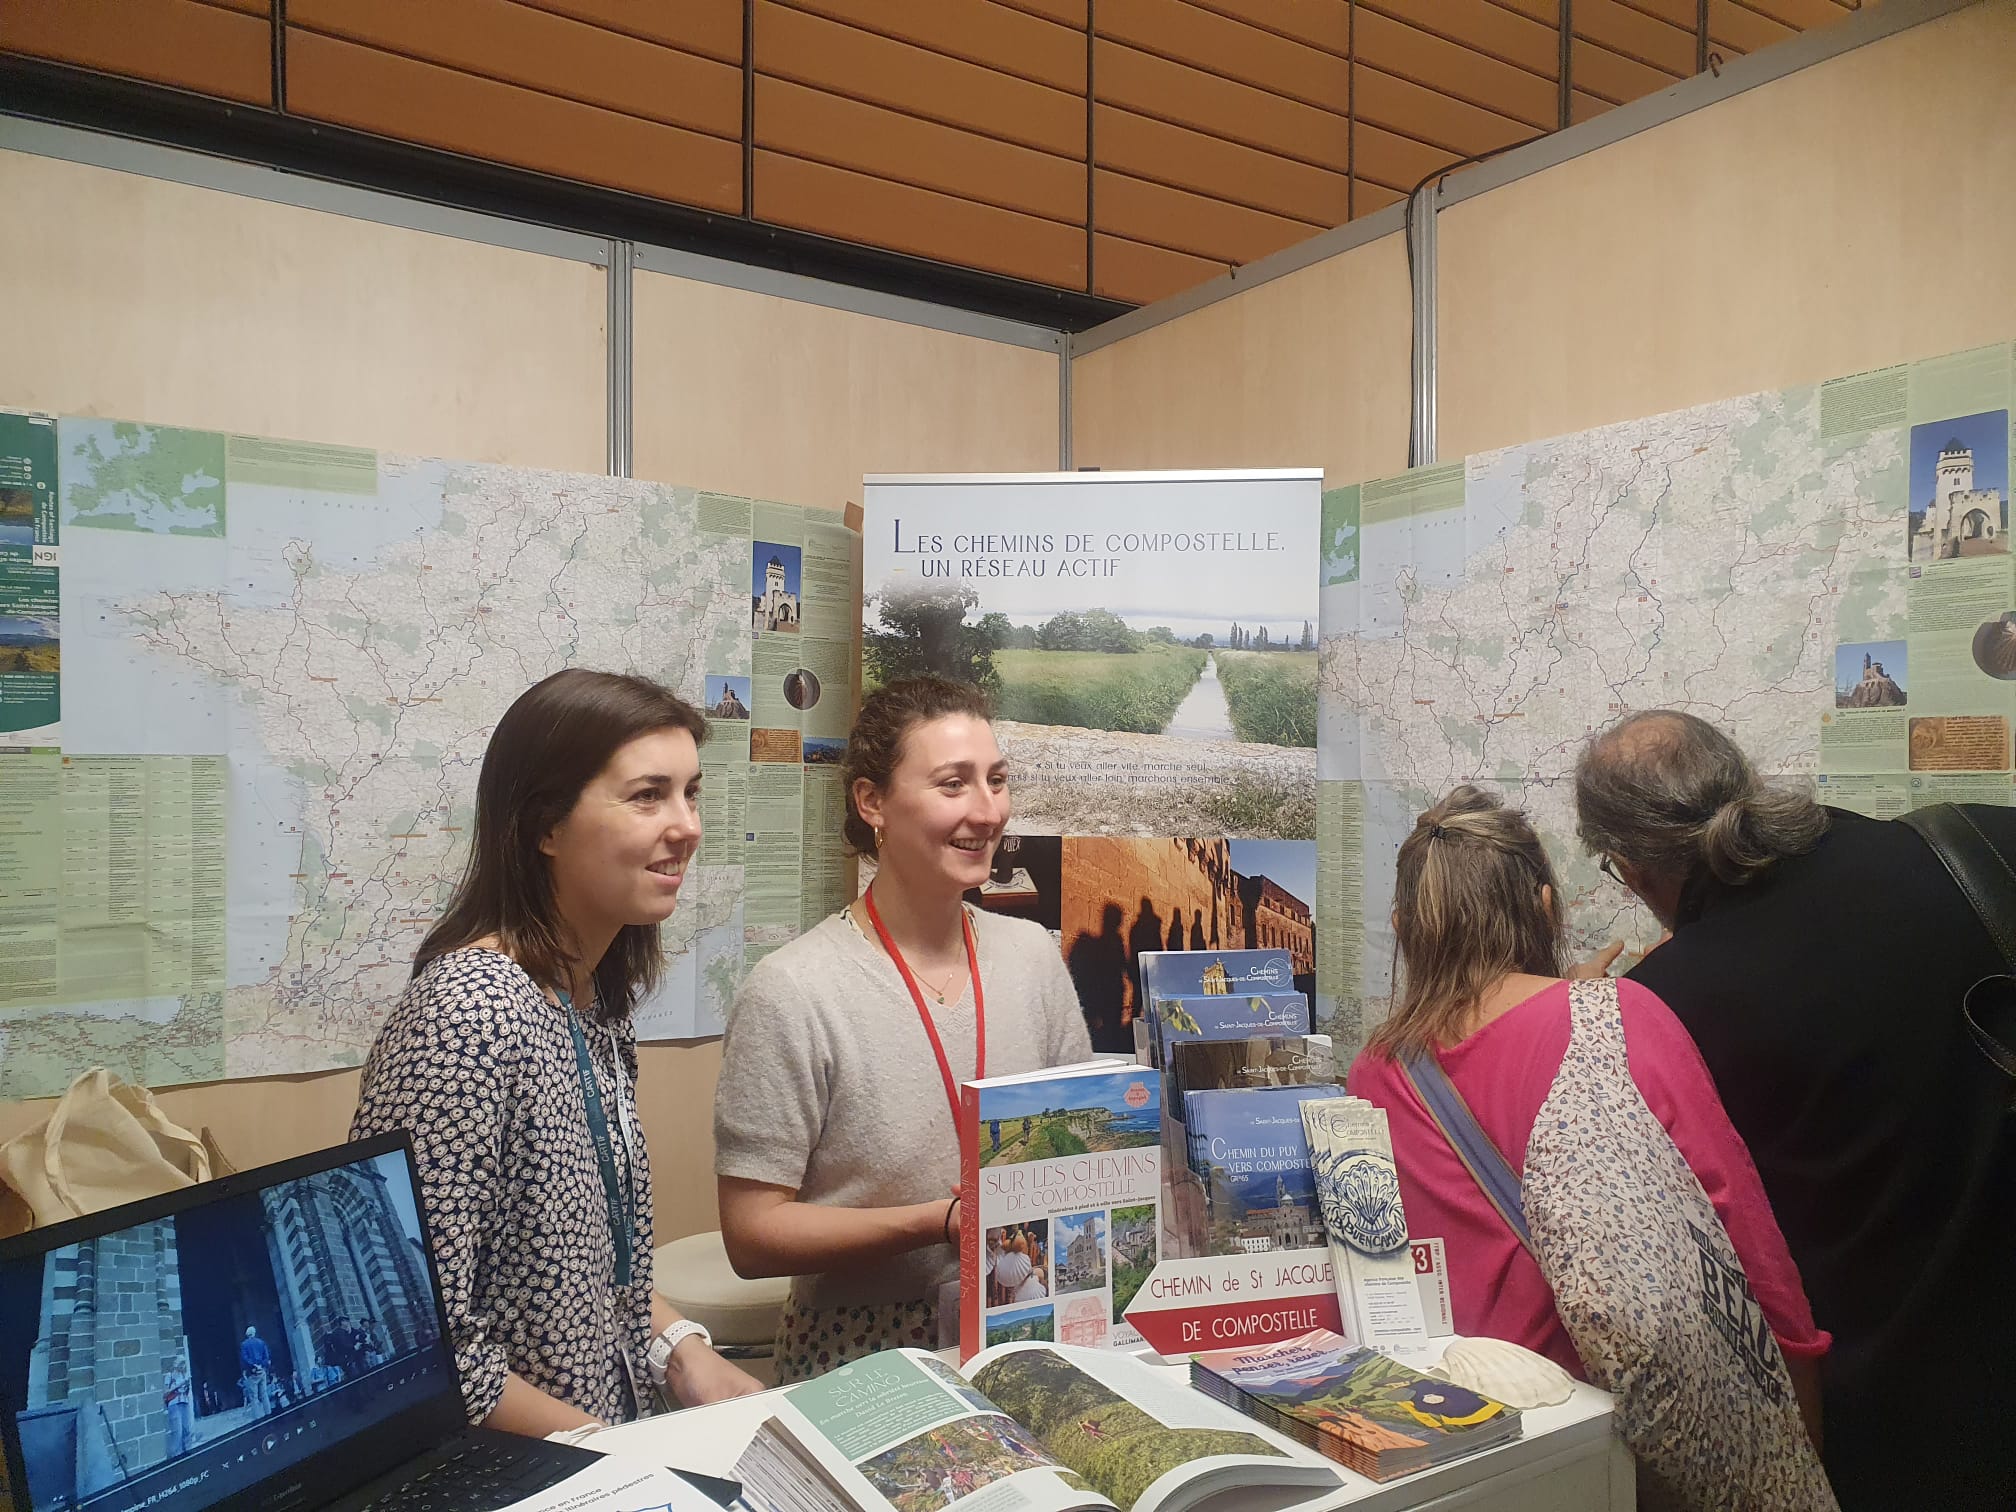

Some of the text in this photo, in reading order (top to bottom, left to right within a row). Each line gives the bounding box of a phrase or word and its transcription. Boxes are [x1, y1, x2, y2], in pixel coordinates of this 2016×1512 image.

[954, 535, 1054, 553] CHEMINS
[1065, 534, 1094, 552] DE
[34, 552, 56, 561] IGN
[922, 556, 1120, 577] UN RÉSEAU ACTIF
[1080, 774, 1102, 782] aller
[1128, 775, 1177, 784] marchons
[1260, 1147, 1274, 1158] DU
[1279, 1146, 1298, 1156] PUY
[986, 1153, 1156, 1196] SUR LES CHEMINS
[1228, 1162, 1252, 1173] VERS
[1007, 1178, 1135, 1211] DE COMPOSTELLE
[1150, 1275, 1212, 1298] CHEMIN
[1222, 1270, 1240, 1292] de
[1250, 1270, 1263, 1288] St
[1182, 1308, 1318, 1342] DE COMPOSTELLE
[1233, 1347, 1312, 1364] Marcher,
[828, 1378, 863, 1394] SUR
[836, 1376, 900, 1406] CAMINO
[612, 1473, 655, 1495] pédestres
[570, 1488, 602, 1502] France
